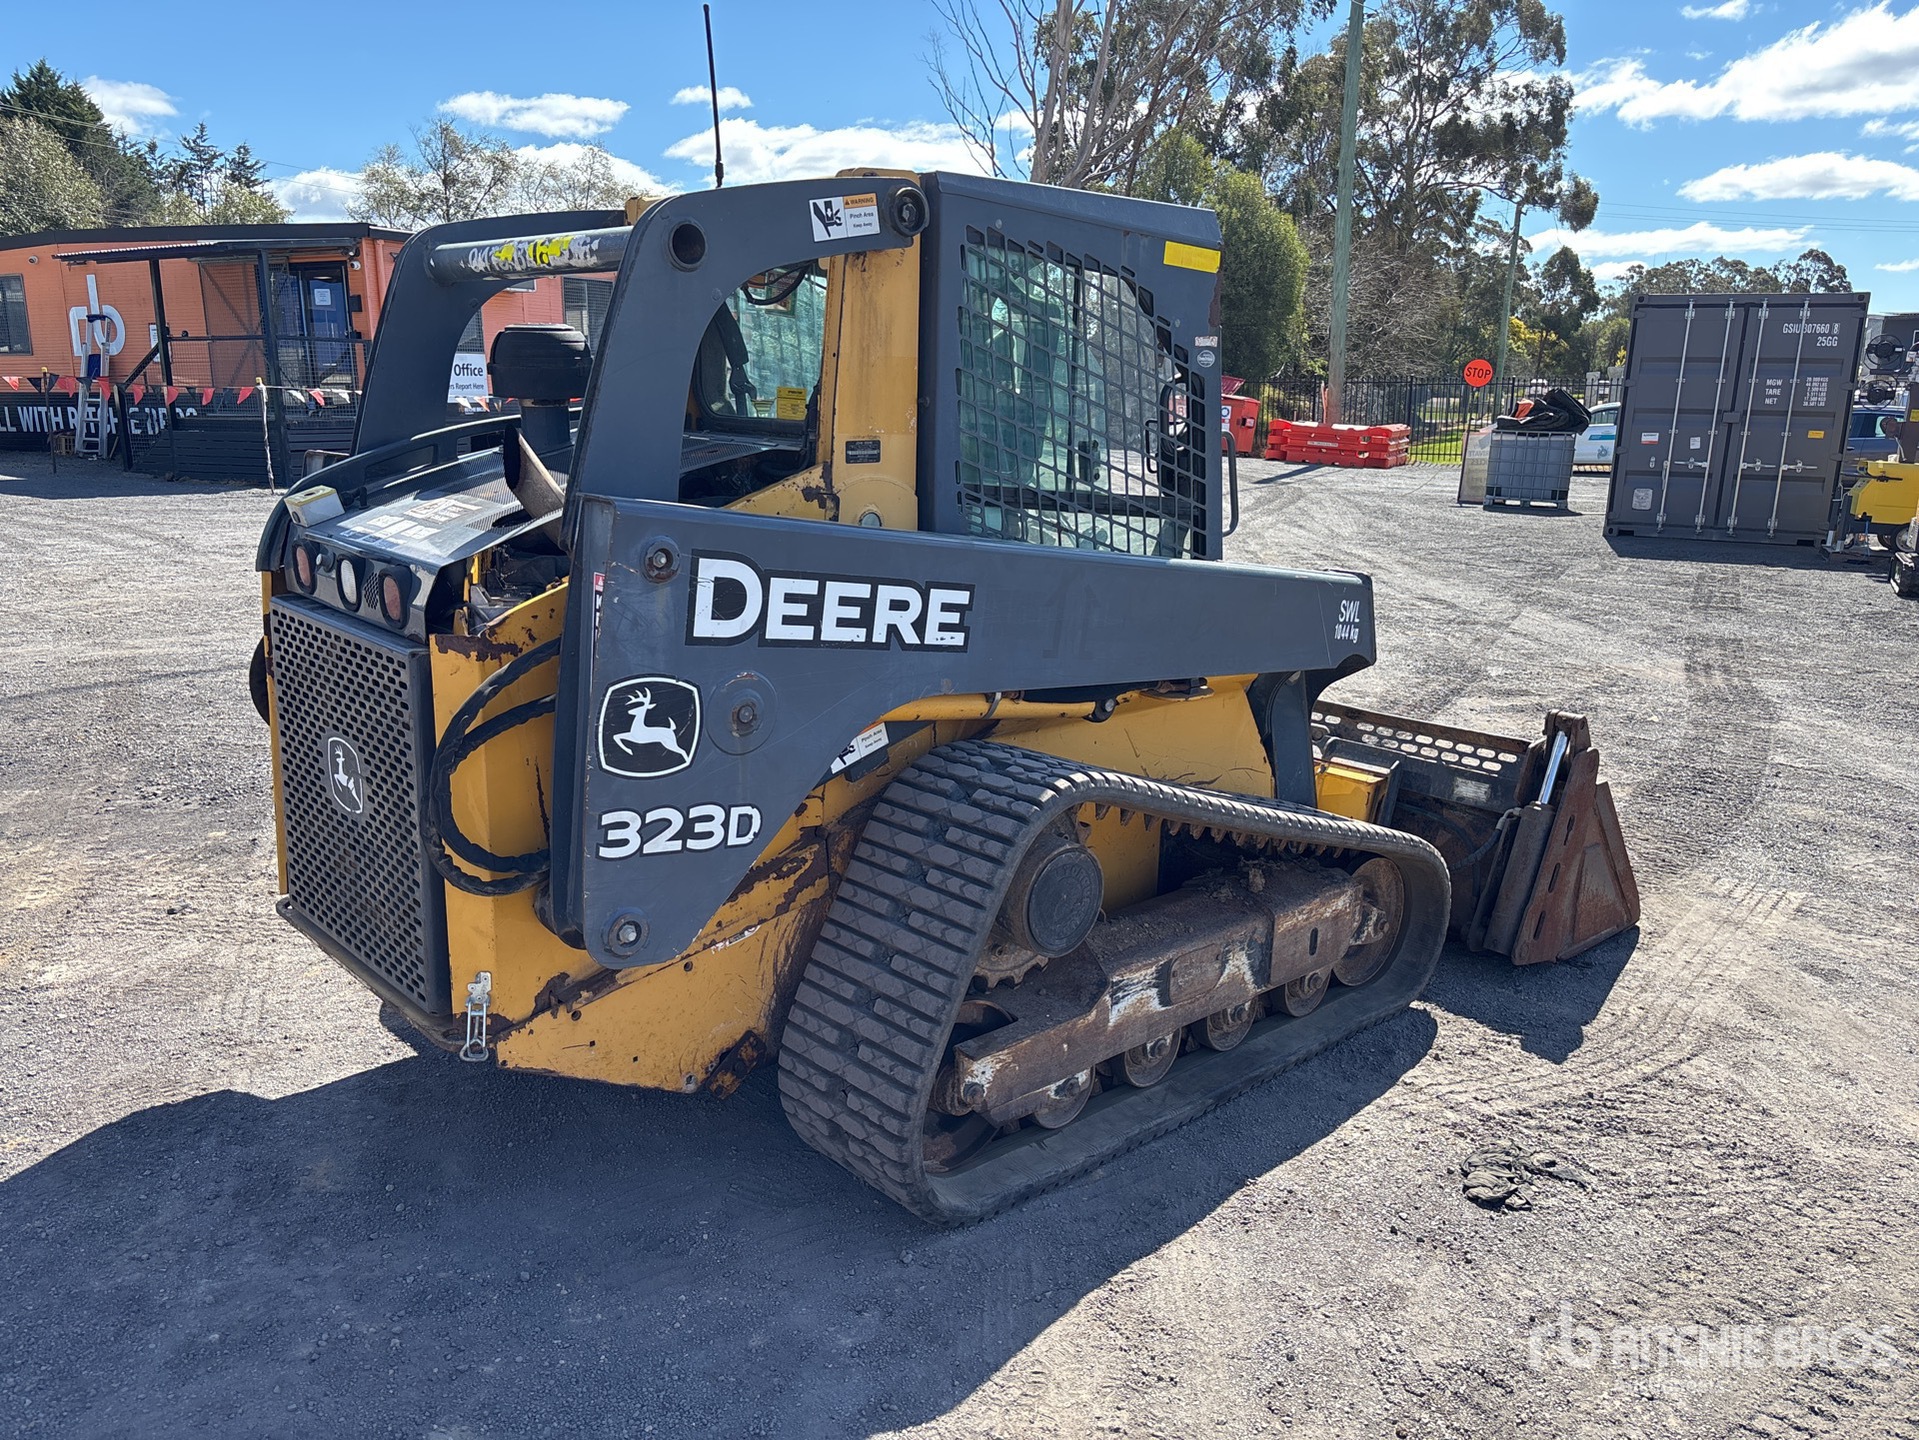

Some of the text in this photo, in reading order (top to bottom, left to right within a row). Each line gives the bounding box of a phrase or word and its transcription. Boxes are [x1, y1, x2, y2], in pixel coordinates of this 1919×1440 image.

[1782, 323, 1801, 334] GSIU
[1816, 336, 1838, 347] 25GG
[453, 363, 484, 377] Office
[1466, 366, 1491, 379] STOP
[455, 383, 472, 391] Report
[17, 406, 64, 432] WITH
[693, 557, 971, 646] DEERE
[1338, 599, 1360, 623] SWL
[1334, 623, 1360, 644] 1044 kg
[599, 804, 761, 859] 323D
